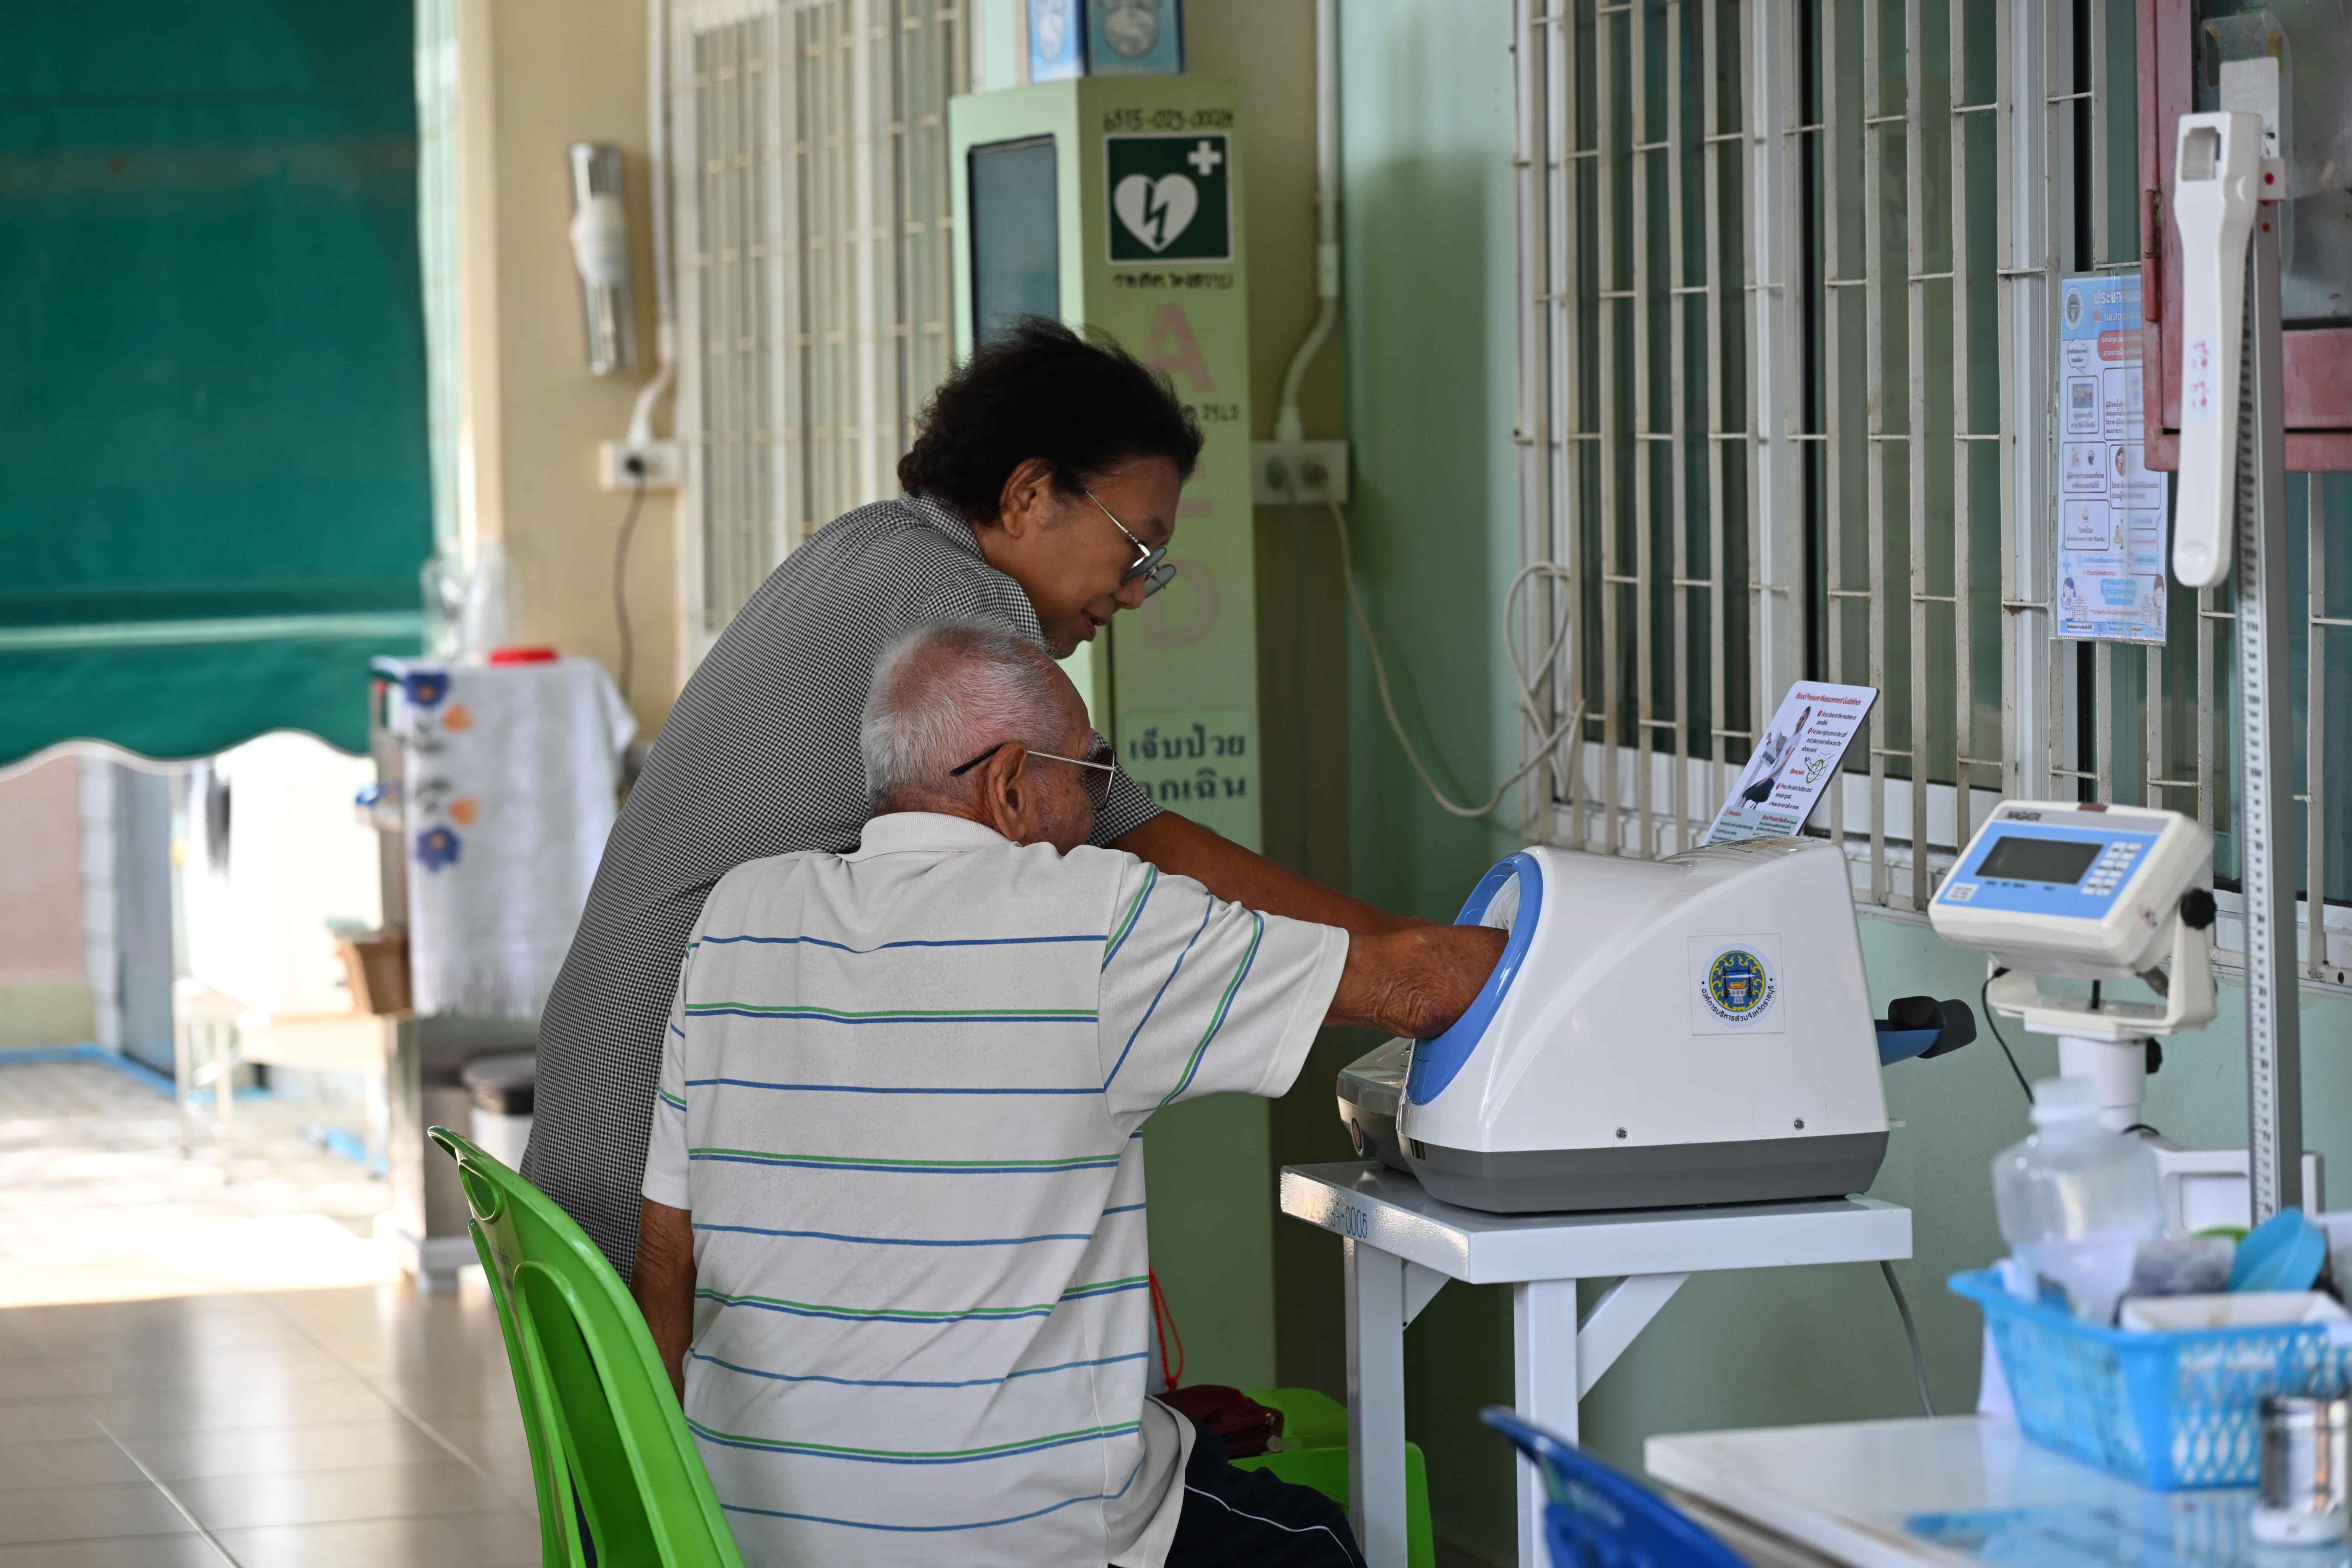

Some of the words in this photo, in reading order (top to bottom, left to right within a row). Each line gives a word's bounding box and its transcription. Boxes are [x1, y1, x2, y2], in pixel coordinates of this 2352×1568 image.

[1806, 693, 1820, 701] Pressure
[1820, 695, 1843, 704] Measurement
[1842, 697, 1862, 705] Guidelines
[1130, 723, 1246, 761] เจ็บป่วย
[1701, 985, 1775, 1022] องค์การบริหารส่วนจังหวัดราชบุรี
